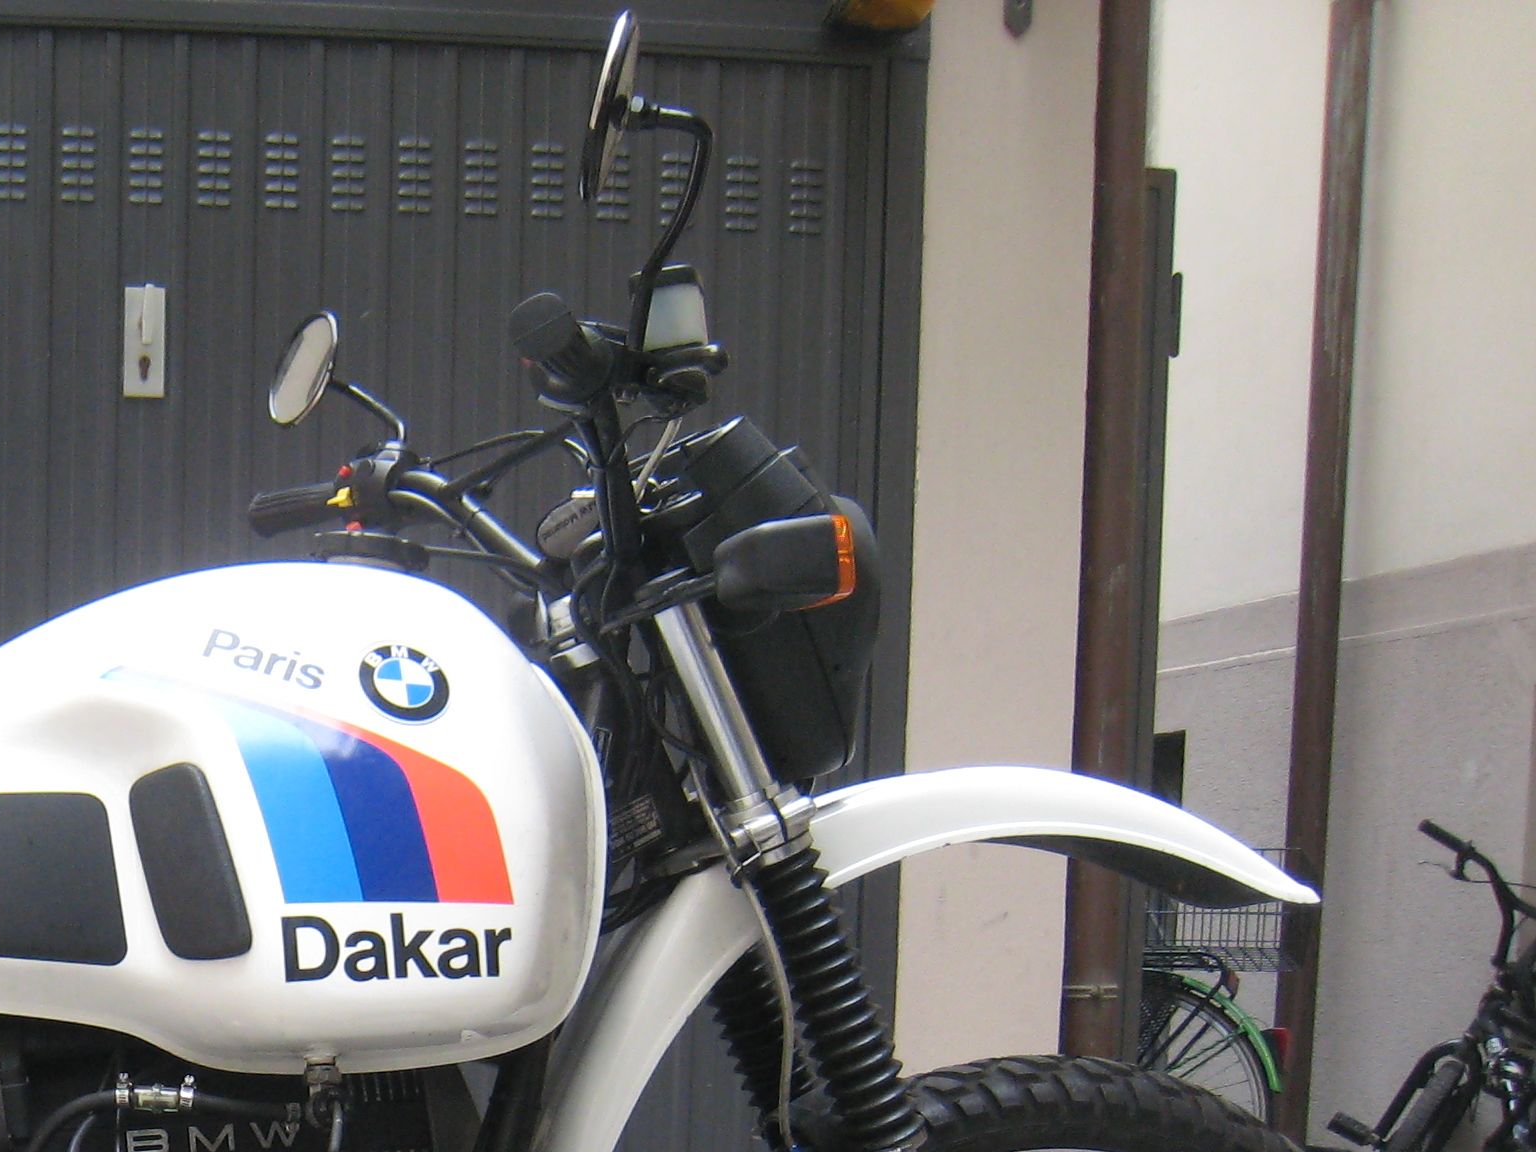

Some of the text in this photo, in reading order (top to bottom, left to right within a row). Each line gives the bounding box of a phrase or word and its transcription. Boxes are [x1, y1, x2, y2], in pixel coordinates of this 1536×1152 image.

[202, 628, 326, 690] Paris
[364, 644, 441, 673] BMW
[281, 913, 512, 982] Dakar
